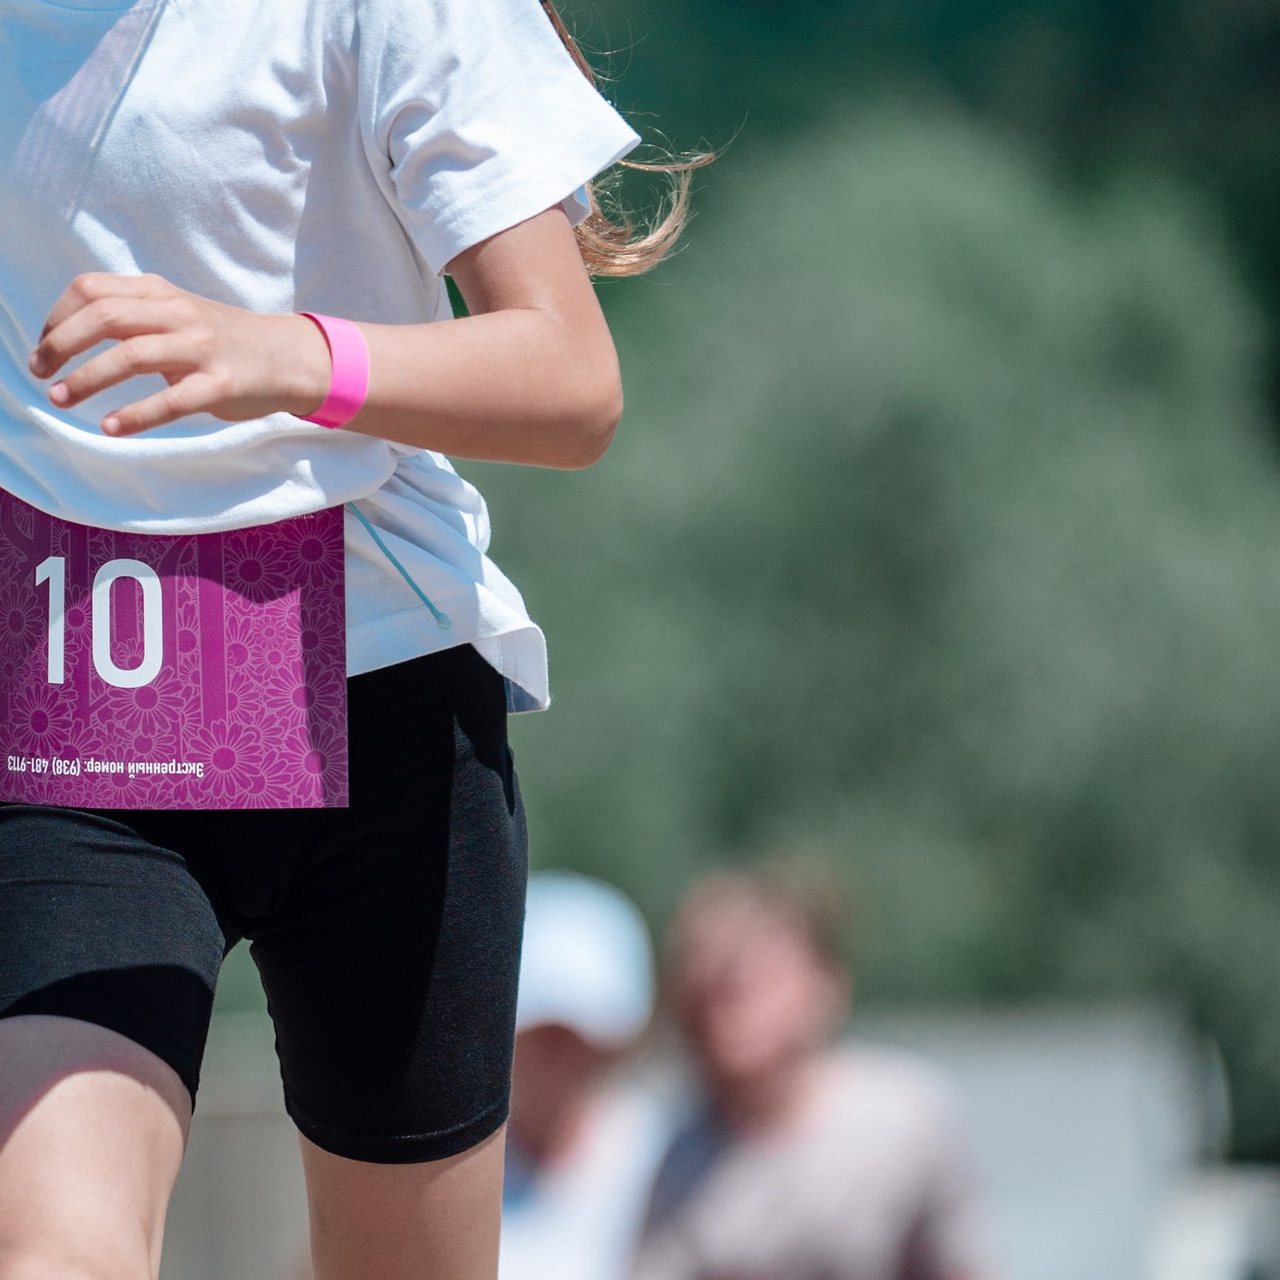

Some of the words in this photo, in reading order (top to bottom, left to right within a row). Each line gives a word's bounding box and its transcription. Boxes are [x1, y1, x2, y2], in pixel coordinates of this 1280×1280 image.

[35, 556, 163, 689] 10
[7, 755, 49, 774] 481-9113
[52, 757, 81, 777] (938)
[84, 757, 124, 774] номер:
[128, 758, 204, 778] Экстренный
